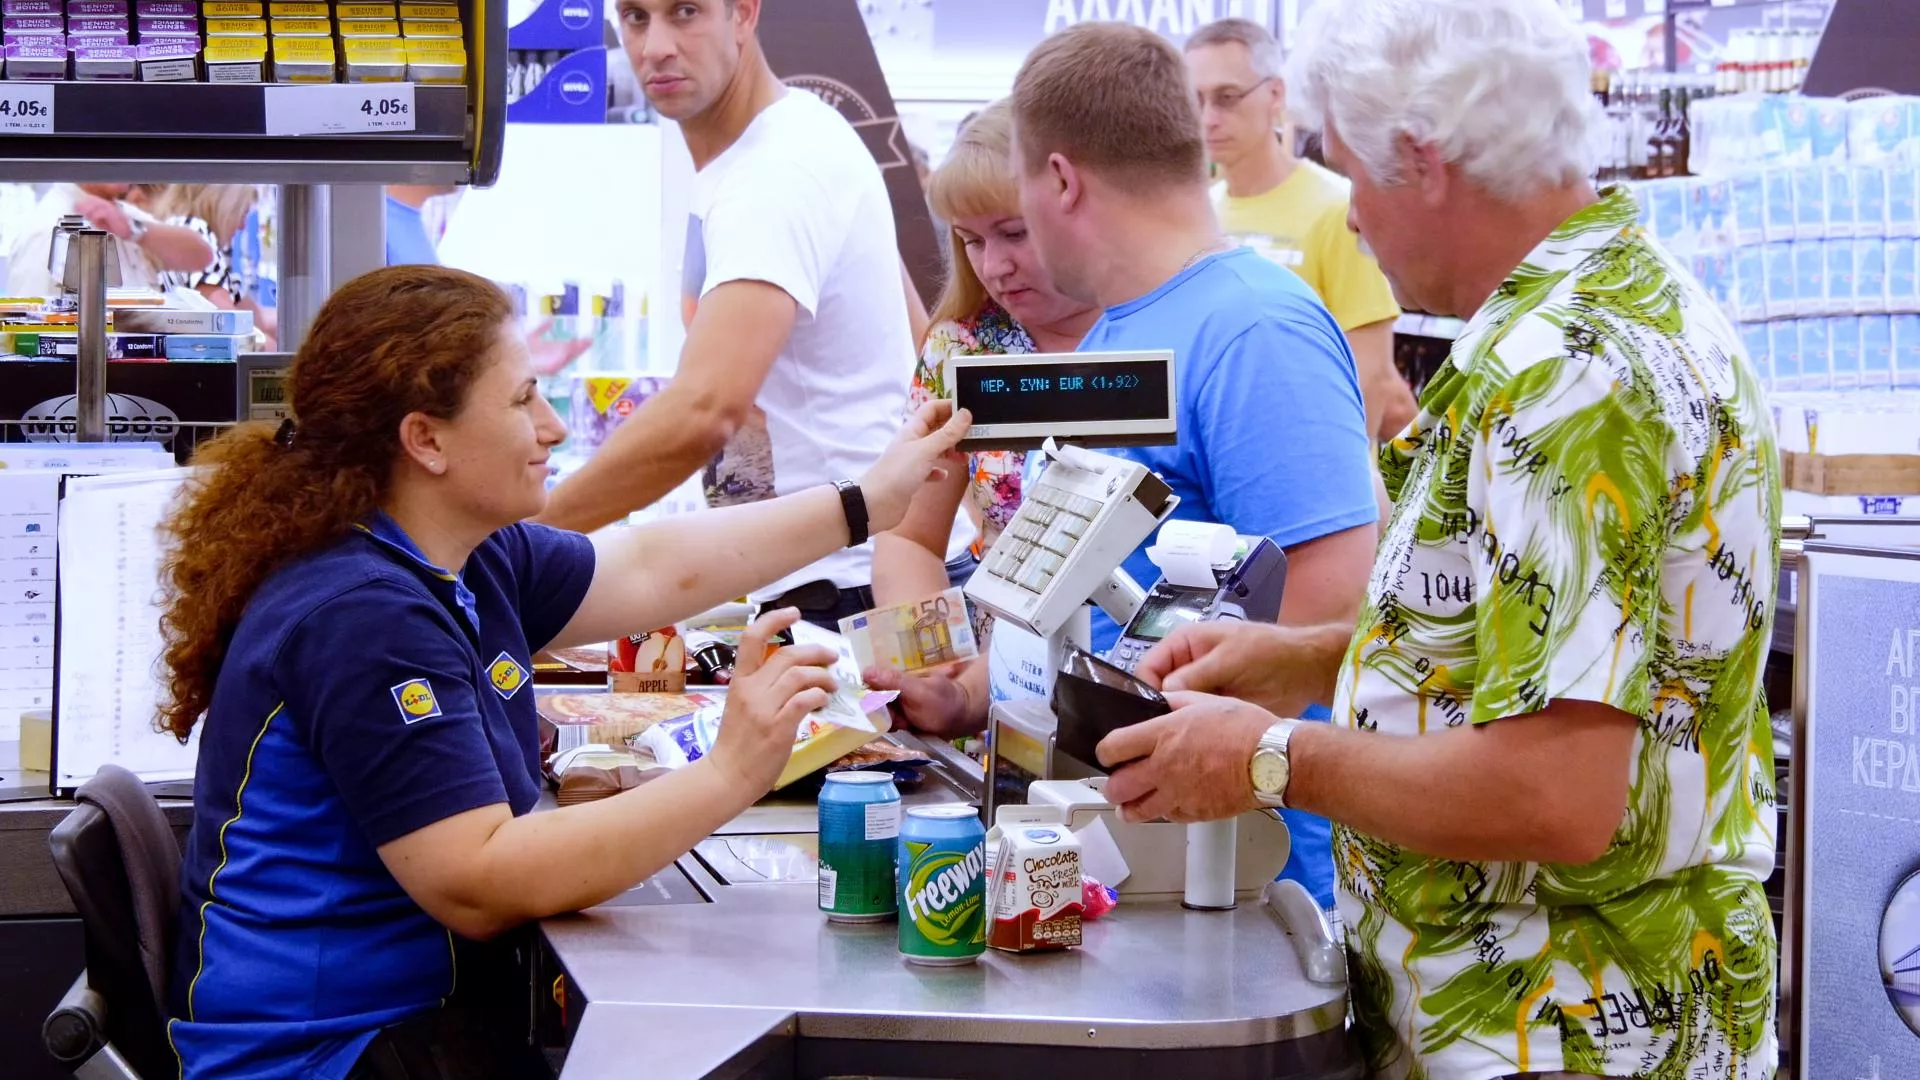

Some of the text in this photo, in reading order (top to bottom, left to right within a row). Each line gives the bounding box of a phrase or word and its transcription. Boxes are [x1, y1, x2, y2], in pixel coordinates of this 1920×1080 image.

[563, 8, 590, 17] NIVEA
[563, 82, 590, 92] NIVEA
[0, 100, 47, 117] 4,05€
[360, 98, 408, 117] 4,05€
[1059, 376, 1084, 390] EUR
[28, 415, 174, 435] MODOS
[920, 596, 950, 618] 50
[638, 679, 669, 693] APPLE
[1023, 849, 1079, 874] Chocolate
[904, 840, 985, 922] Freeway
[1713, 1050, 1725, 1073] AND
